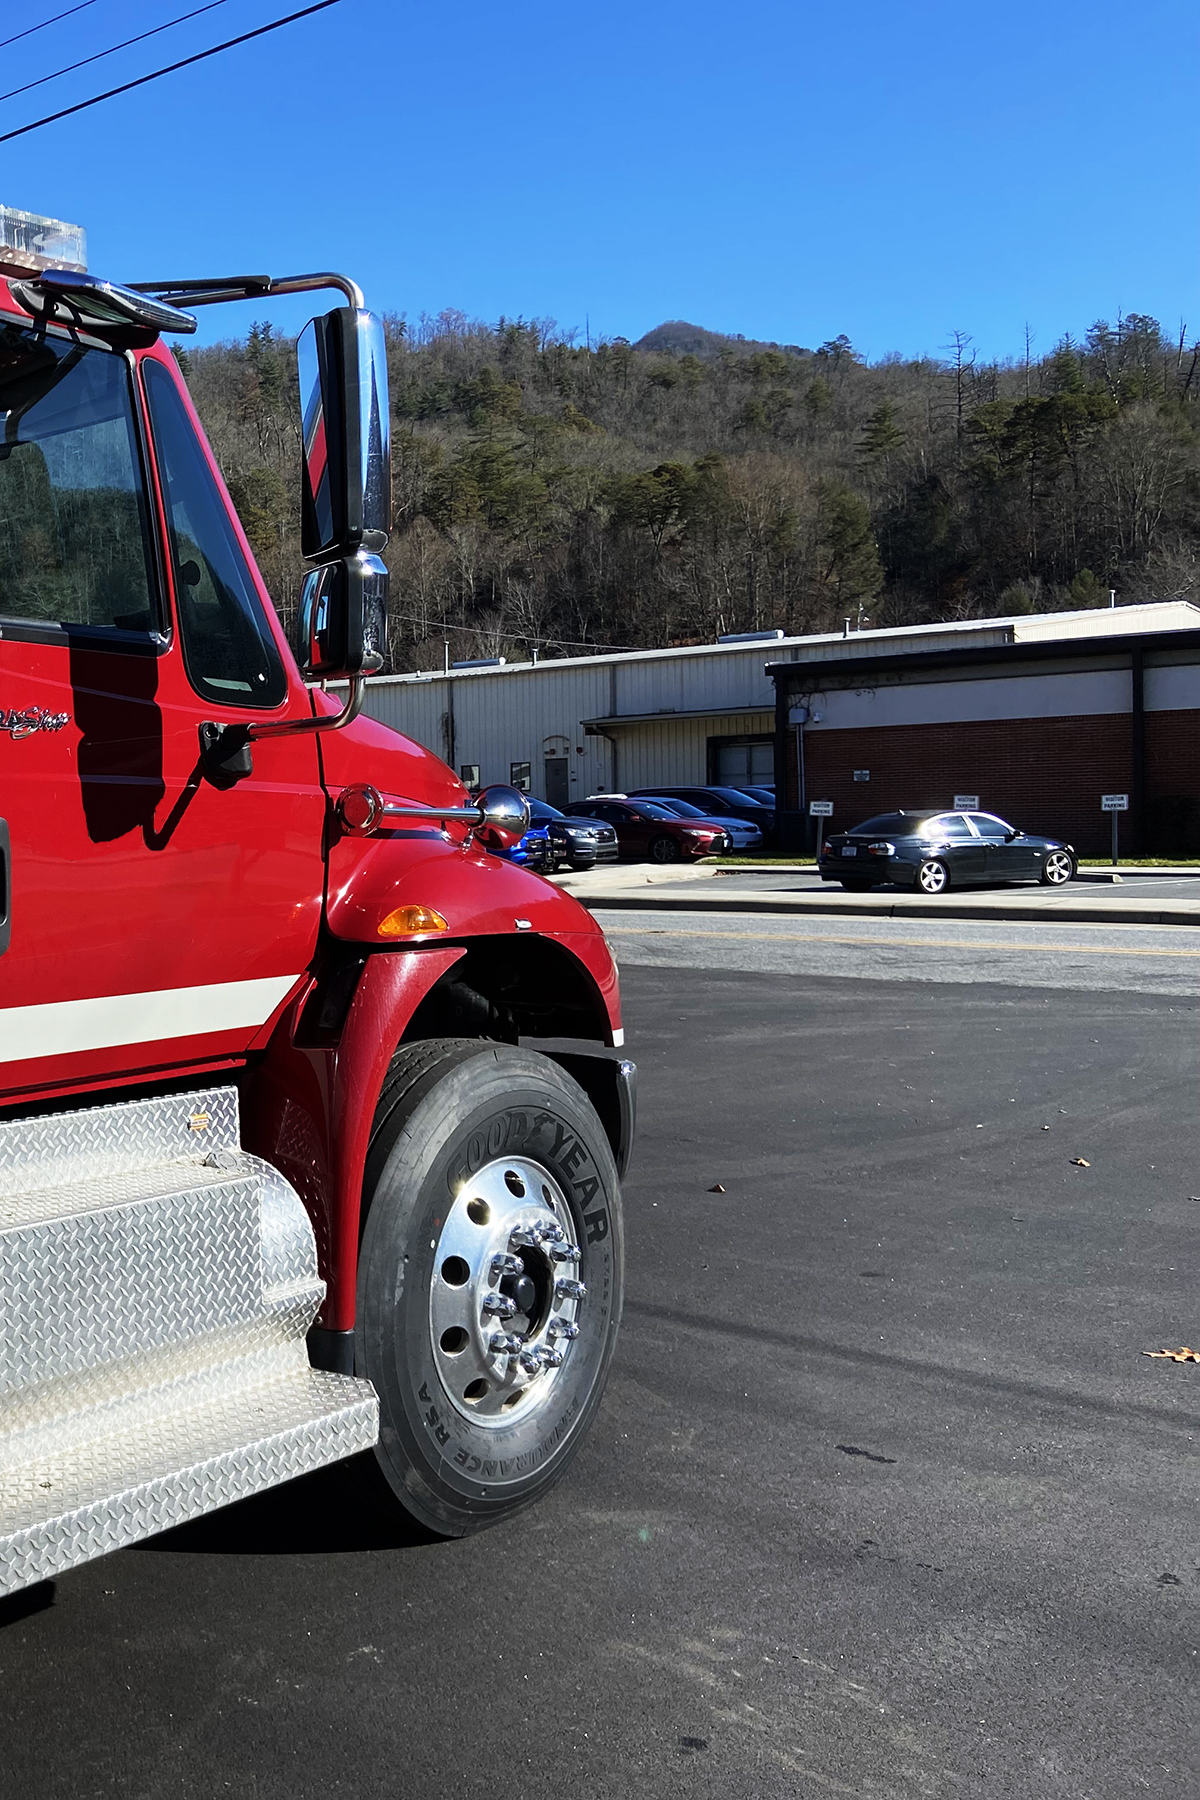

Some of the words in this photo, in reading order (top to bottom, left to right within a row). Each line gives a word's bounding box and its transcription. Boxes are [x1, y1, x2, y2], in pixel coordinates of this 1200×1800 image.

[447, 1111, 608, 1245] GOODYEAR
[417, 1380, 450, 1447] RSA
[453, 1396, 579, 1477] ENDURANCE
